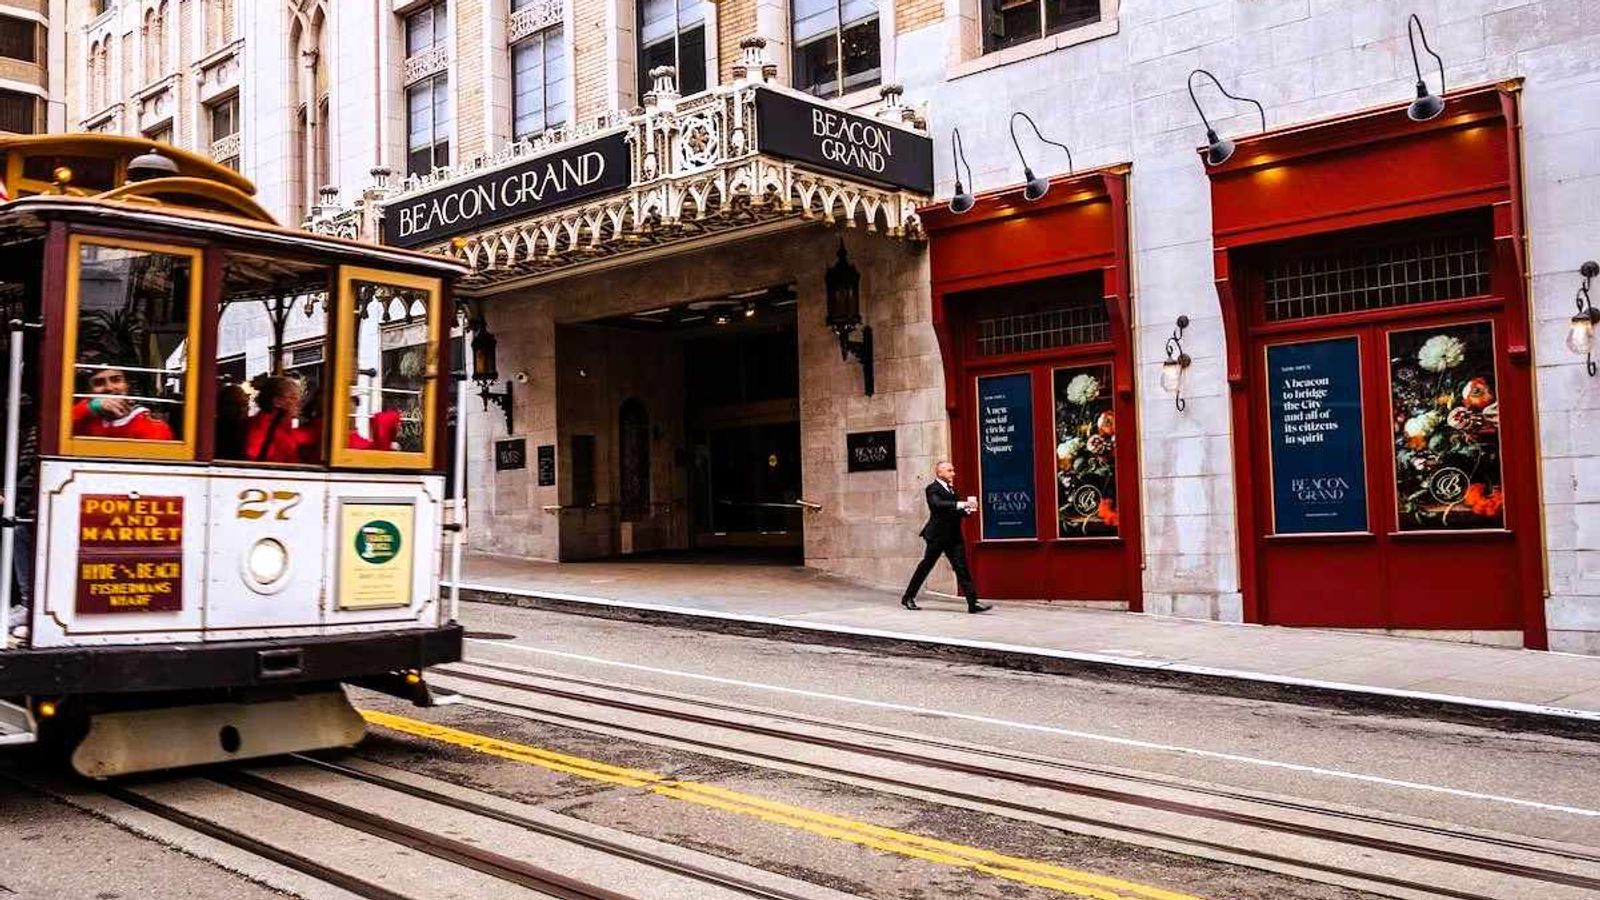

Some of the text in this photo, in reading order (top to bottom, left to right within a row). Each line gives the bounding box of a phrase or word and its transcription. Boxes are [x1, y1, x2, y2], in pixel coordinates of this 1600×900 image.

[814, 108, 892, 155] BEACON
[821, 139, 885, 172] GRAND
[399, 151, 605, 238] BEACON GRAND
[1282, 378, 1329, 389] A beacon
[1283, 388, 1328, 400] to bridge
[1283, 399, 1322, 411] the City
[985, 415, 1008, 424] social
[1284, 408, 1331, 422] and all of
[985, 424, 1015, 434] circle at
[1284, 420, 1339, 433] its citizens
[985, 435, 1008, 443] Union
[1285, 432, 1324, 445] in spirit
[985, 444, 1013, 454] Square
[1291, 477, 1350, 492] BEACON
[988, 491, 1030, 503] BEACON
[1298, 489, 1344, 501] GRAND
[85, 499, 180, 515] POWELL
[237, 489, 302, 520] 27
[993, 501, 1027, 512] GRAND
[109, 515, 158, 527] AND
[82, 527, 181, 541] MARKET
[82, 564, 117, 580] HYDE
[136, 562, 180, 579] BEACH
[90, 582, 173, 595] FISHERMANS
[109, 594, 153, 606] WHARF
